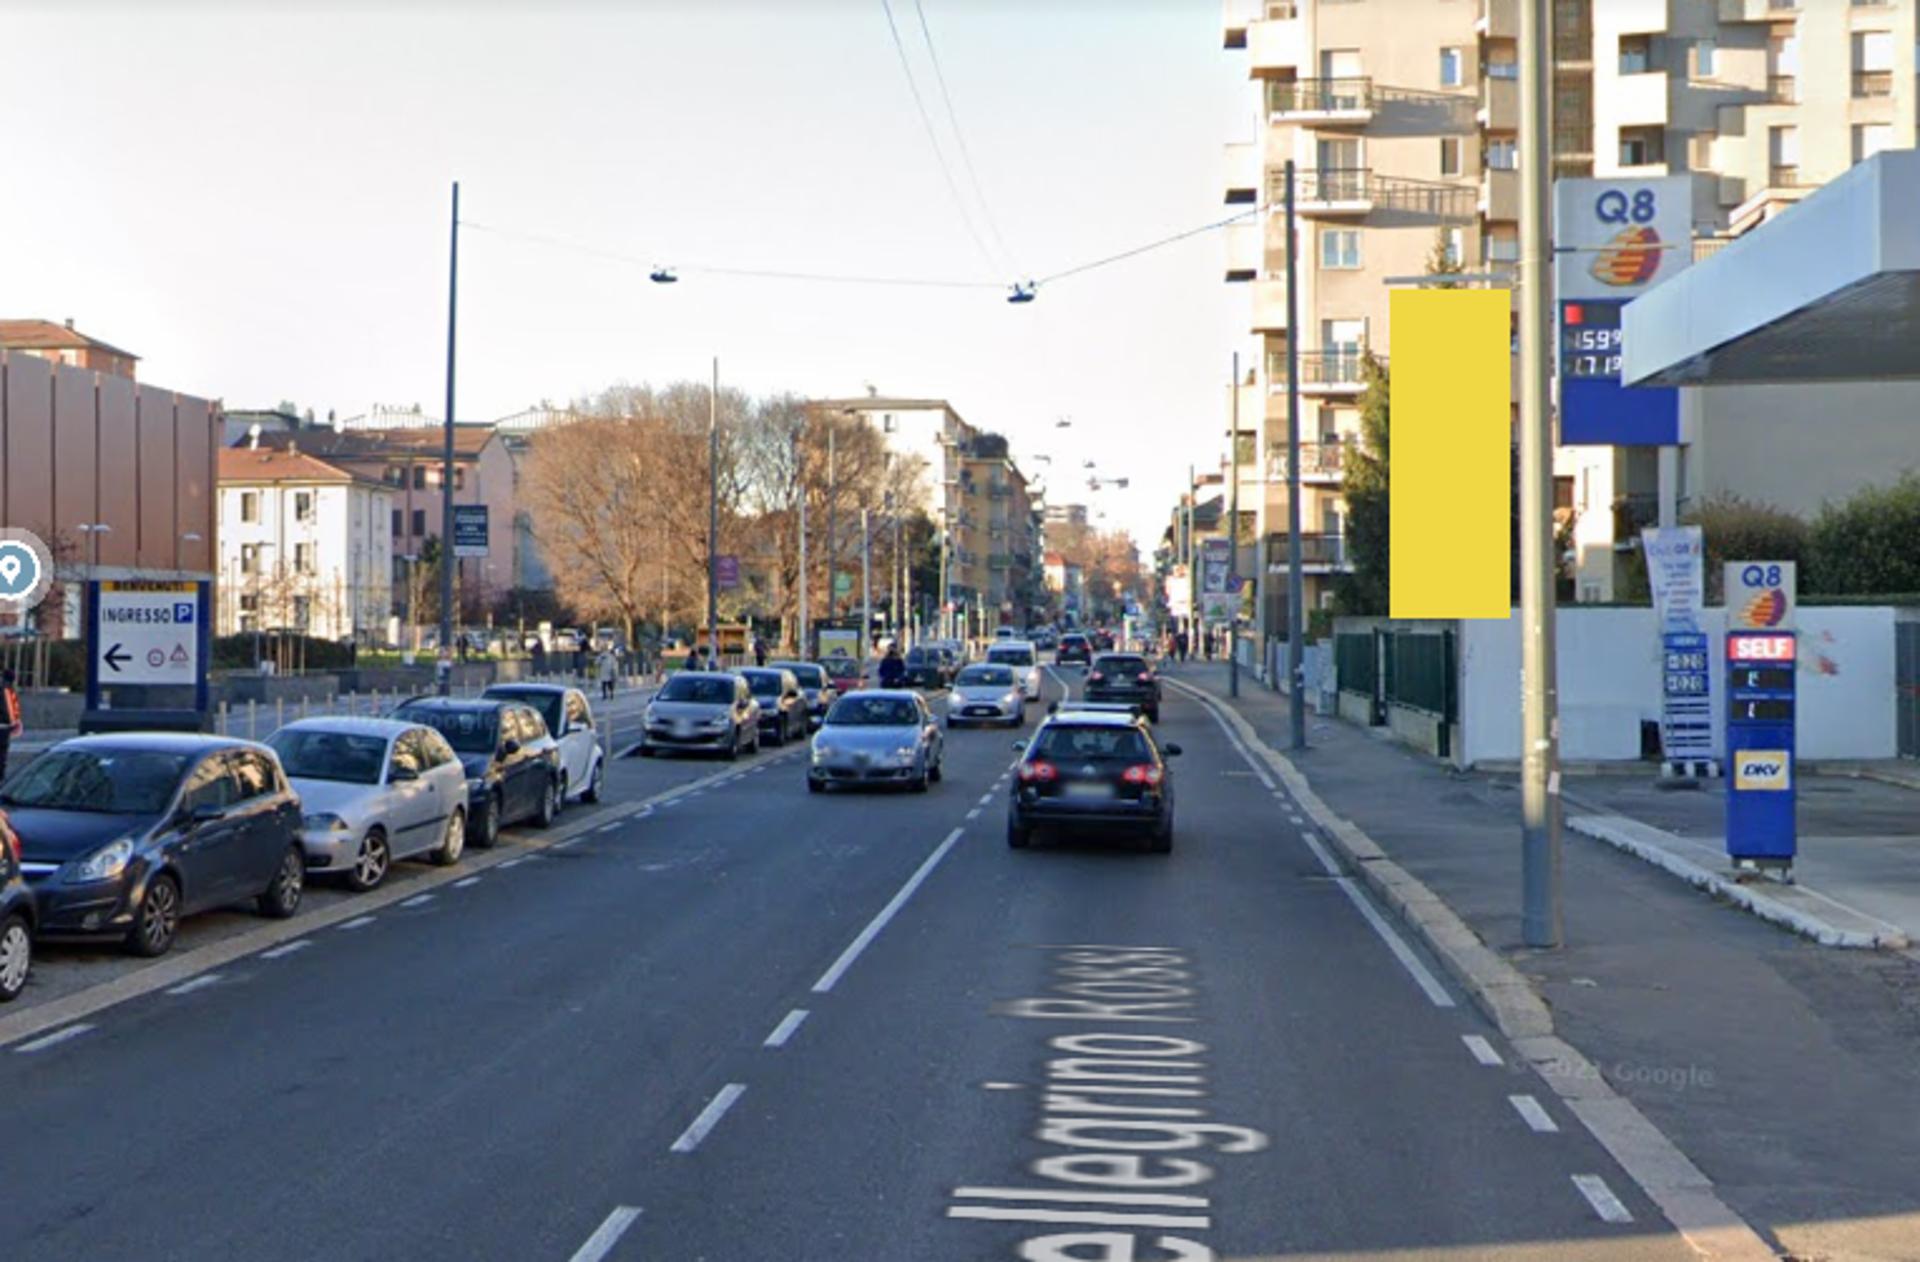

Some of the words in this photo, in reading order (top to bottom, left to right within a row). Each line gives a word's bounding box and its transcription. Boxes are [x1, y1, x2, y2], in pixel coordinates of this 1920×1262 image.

[1595, 189, 1656, 225] Q8
[1742, 565, 1782, 588] Q8
[102, 608, 172, 624] INGRESSO
[1737, 637, 1789, 660] SELF
[1743, 764, 1780, 776] DKV
